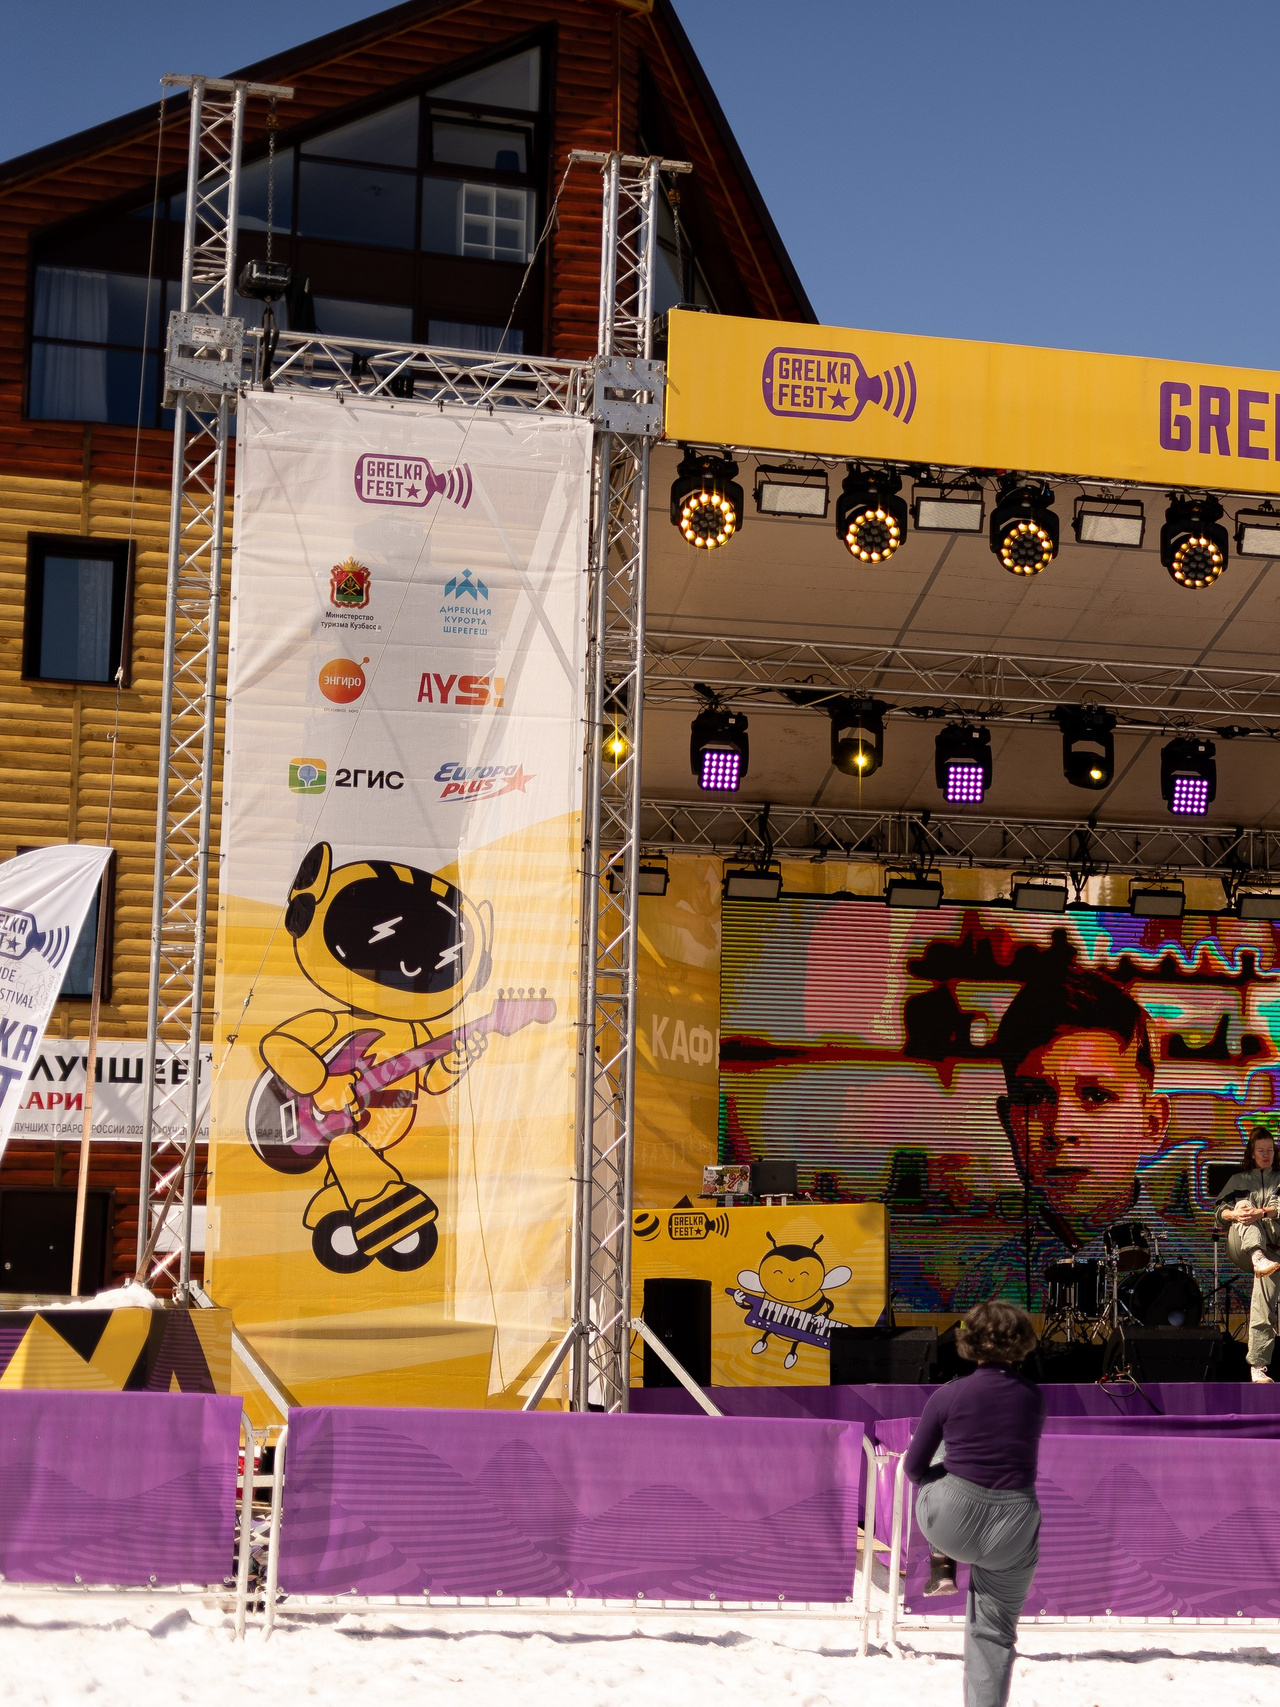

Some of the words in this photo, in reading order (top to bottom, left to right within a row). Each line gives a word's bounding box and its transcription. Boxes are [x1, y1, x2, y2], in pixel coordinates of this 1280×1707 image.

[778, 356, 851, 384] GRELKA
[778, 384, 828, 409] FEST
[366, 460, 422, 481] GRELKA
[366, 479, 405, 498] FEST
[325, 611, 374, 621] Министерство
[440, 605, 492, 616] ДИРЕКЦИЯ
[321, 621, 349, 629] туризма
[444, 616, 487, 625] КУРОРТА
[443, 626, 488, 636] ШЕРЕГЕШ
[417, 672, 505, 708] AYS!
[335, 768, 404, 790] 2ГИС
[13, 1122, 48, 1133] ЛУЧШИХ
[51, 1123, 83, 1134] ТОВАРО
[673, 1215, 704, 1228] GRELKA
[673, 1226, 696, 1238] FEST
